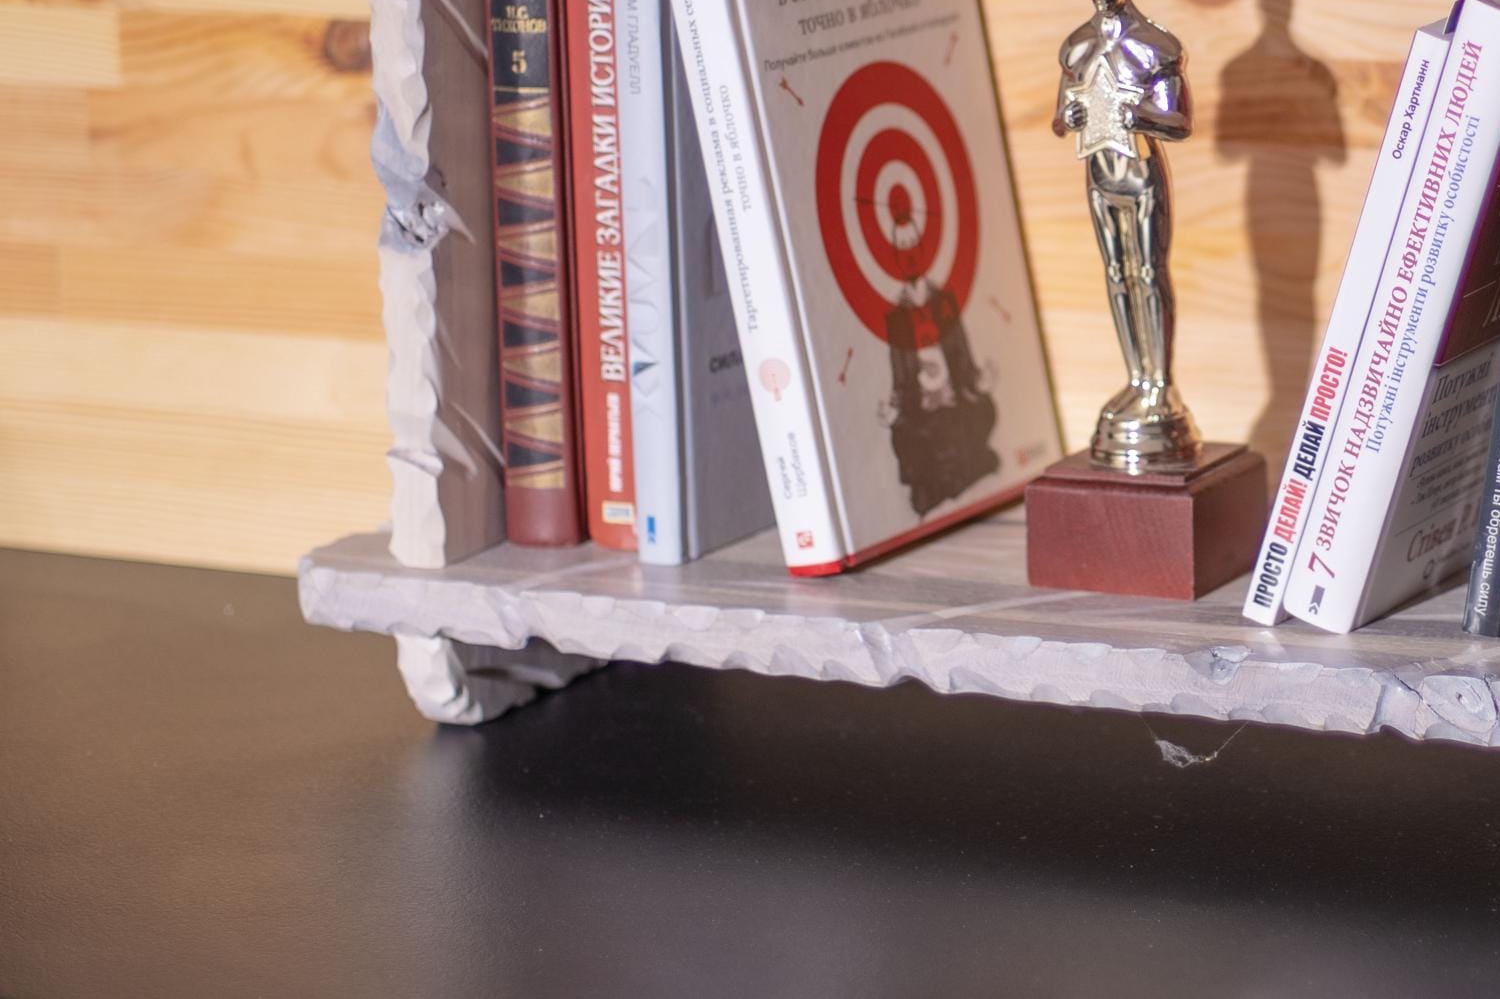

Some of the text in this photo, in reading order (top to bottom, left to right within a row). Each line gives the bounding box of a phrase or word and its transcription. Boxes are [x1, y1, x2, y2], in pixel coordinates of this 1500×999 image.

[511, 50, 528, 74] 5
[1392, 59, 1430, 160] Оскар Хартманн
[592, 114, 622, 246] ЗАГАДКИ
[597, 250, 626, 383] ВЕЛИКИЕ
[1308, 39, 1483, 579] 7 ЗВИЧОК НАДЗВИЧАЙНО ЕФЕКТИВНИХ ЛЮДЕЙ
[1365, 114, 1480, 453] Потужні інструменти розвитку особистості
[1253, 346, 1348, 609] ПРОСТО ДЕЛАЙ! ДЕЛАЙ ПРОСТО!
[1473, 583, 1491, 618] силу
